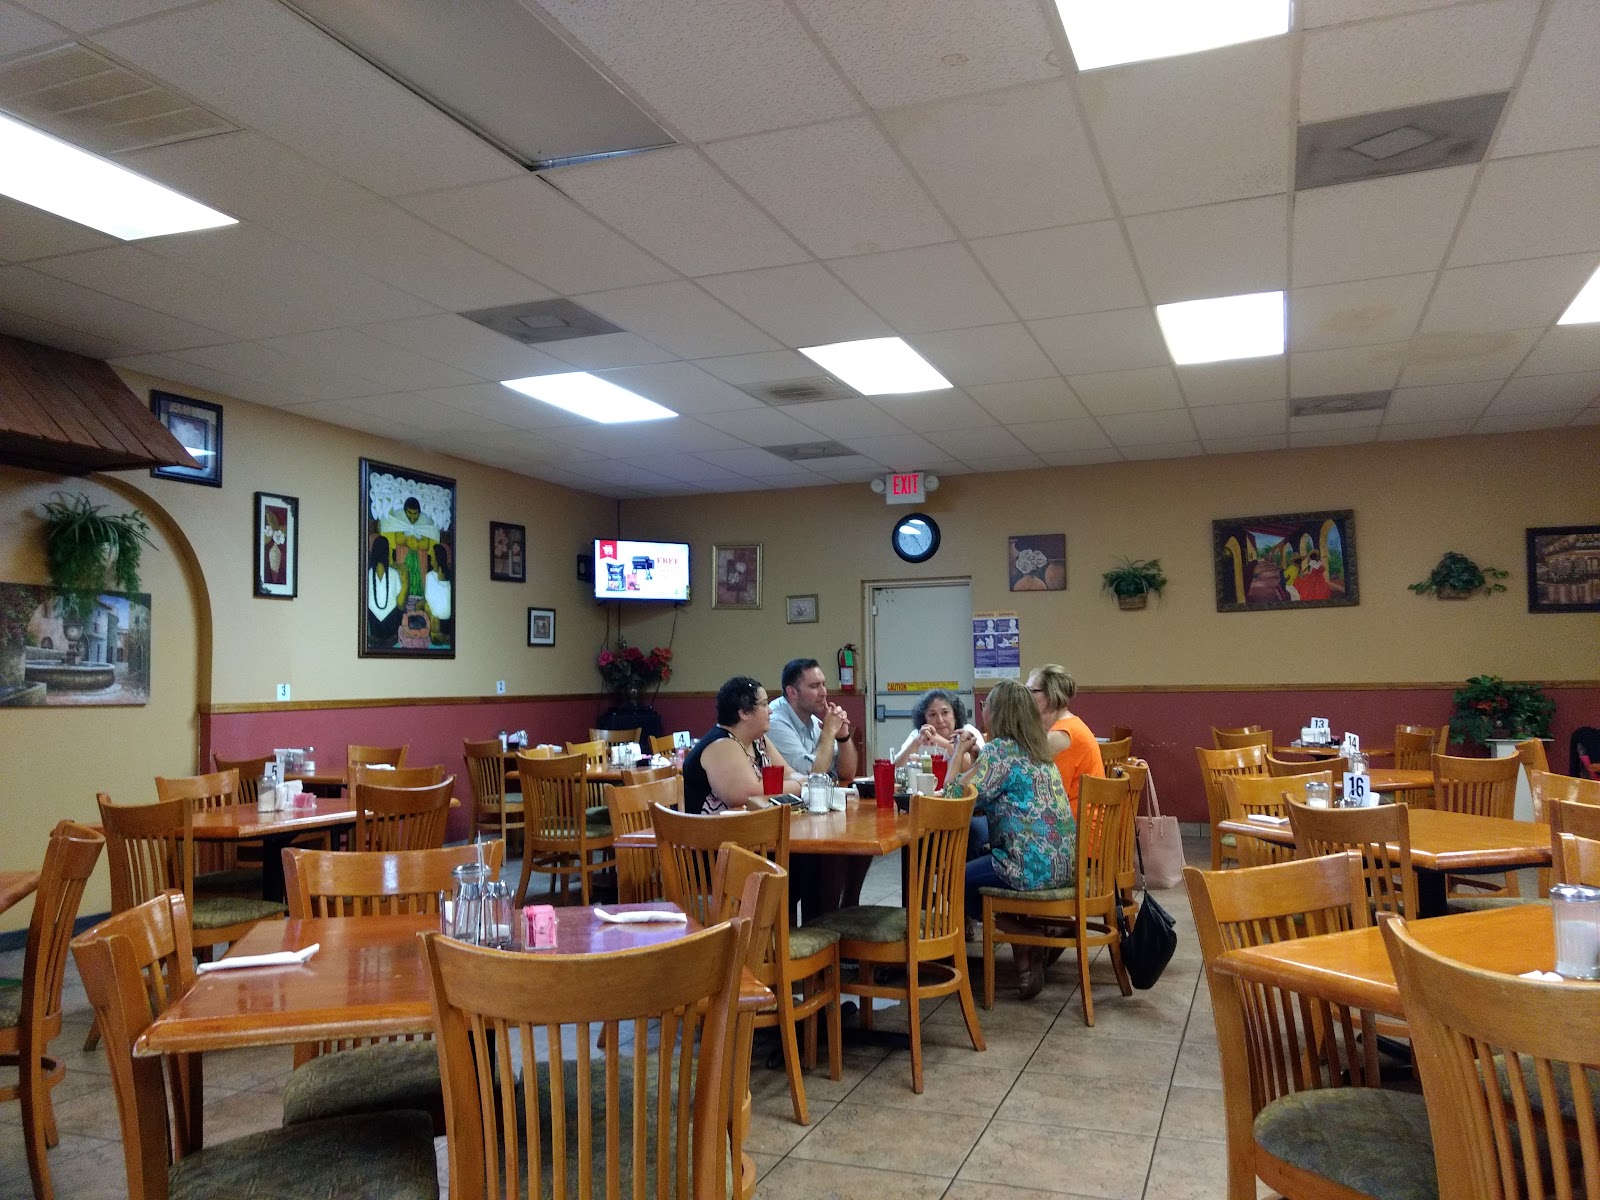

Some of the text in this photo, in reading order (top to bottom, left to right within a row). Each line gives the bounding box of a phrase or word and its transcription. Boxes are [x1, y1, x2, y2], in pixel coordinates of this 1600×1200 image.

[893, 474, 919, 495] EXIT
[281, 685, 286, 696] 3
[1314, 719, 1325, 729] 13
[1348, 735, 1357, 747] 14
[271, 765, 278, 776] 5
[1349, 776, 1364, 797] 16
